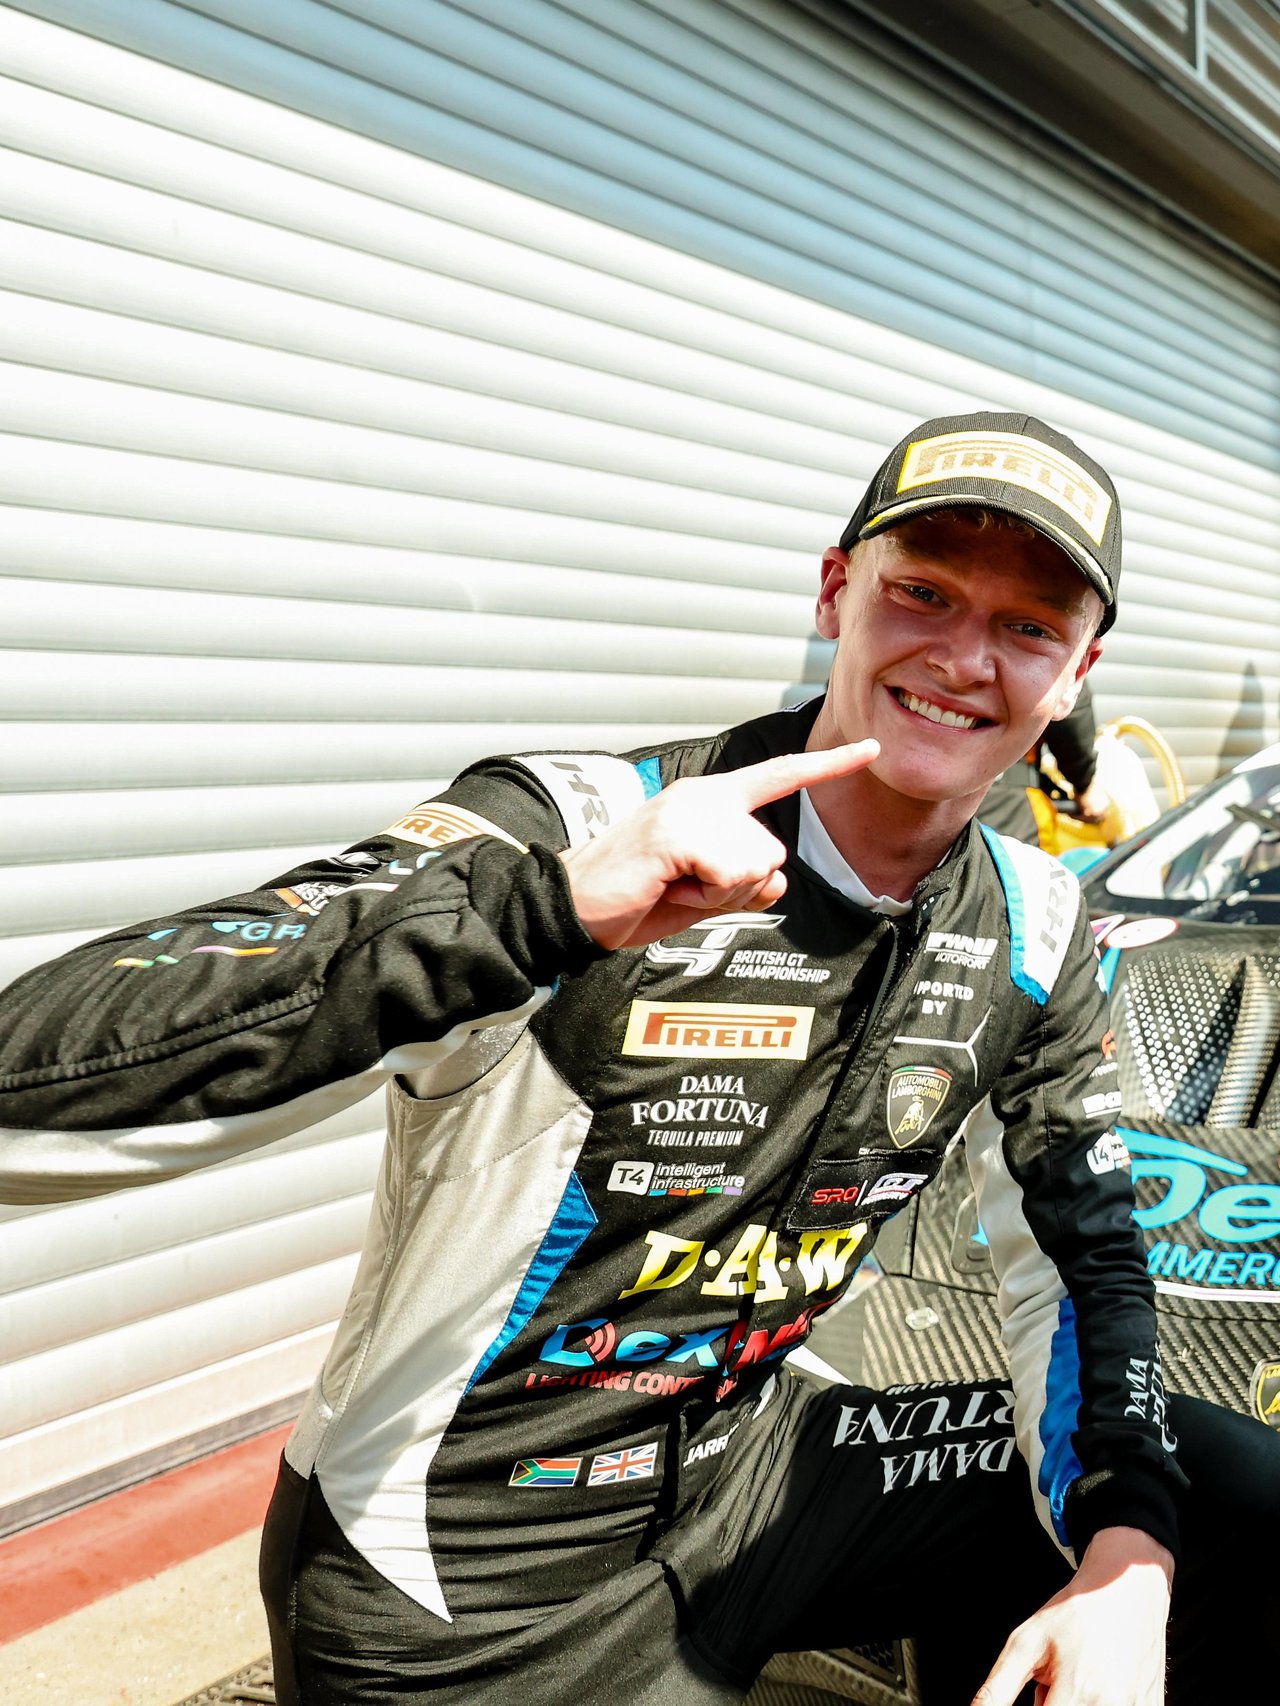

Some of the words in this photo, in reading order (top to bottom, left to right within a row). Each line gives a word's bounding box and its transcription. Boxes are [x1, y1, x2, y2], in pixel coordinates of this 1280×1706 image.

[914, 440, 1097, 522] PIRELLI
[731, 950, 786, 968] BRITISH
[787, 953, 808, 967] GT
[725, 965, 831, 984] CHAMPIONSHIP
[921, 999, 947, 1015] BY
[642, 1012, 797, 1048] PIRELLI
[678, 1075, 745, 1095] DAMA
[897, 1075, 943, 1090] AUTOMOBILI
[892, 1085, 943, 1101] LAMBORGHINI
[630, 1098, 769, 1129] FORTUNA
[647, 1130, 693, 1147] TEQUILA
[695, 1130, 744, 1147] PREMIUM
[617, 1168, 645, 1186] T4
[656, 1162, 726, 1178] intelligent
[651, 1175, 745, 1190] infrastructure
[811, 1186, 859, 1205] SRO
[880, 1437, 1016, 1495] DAMA
